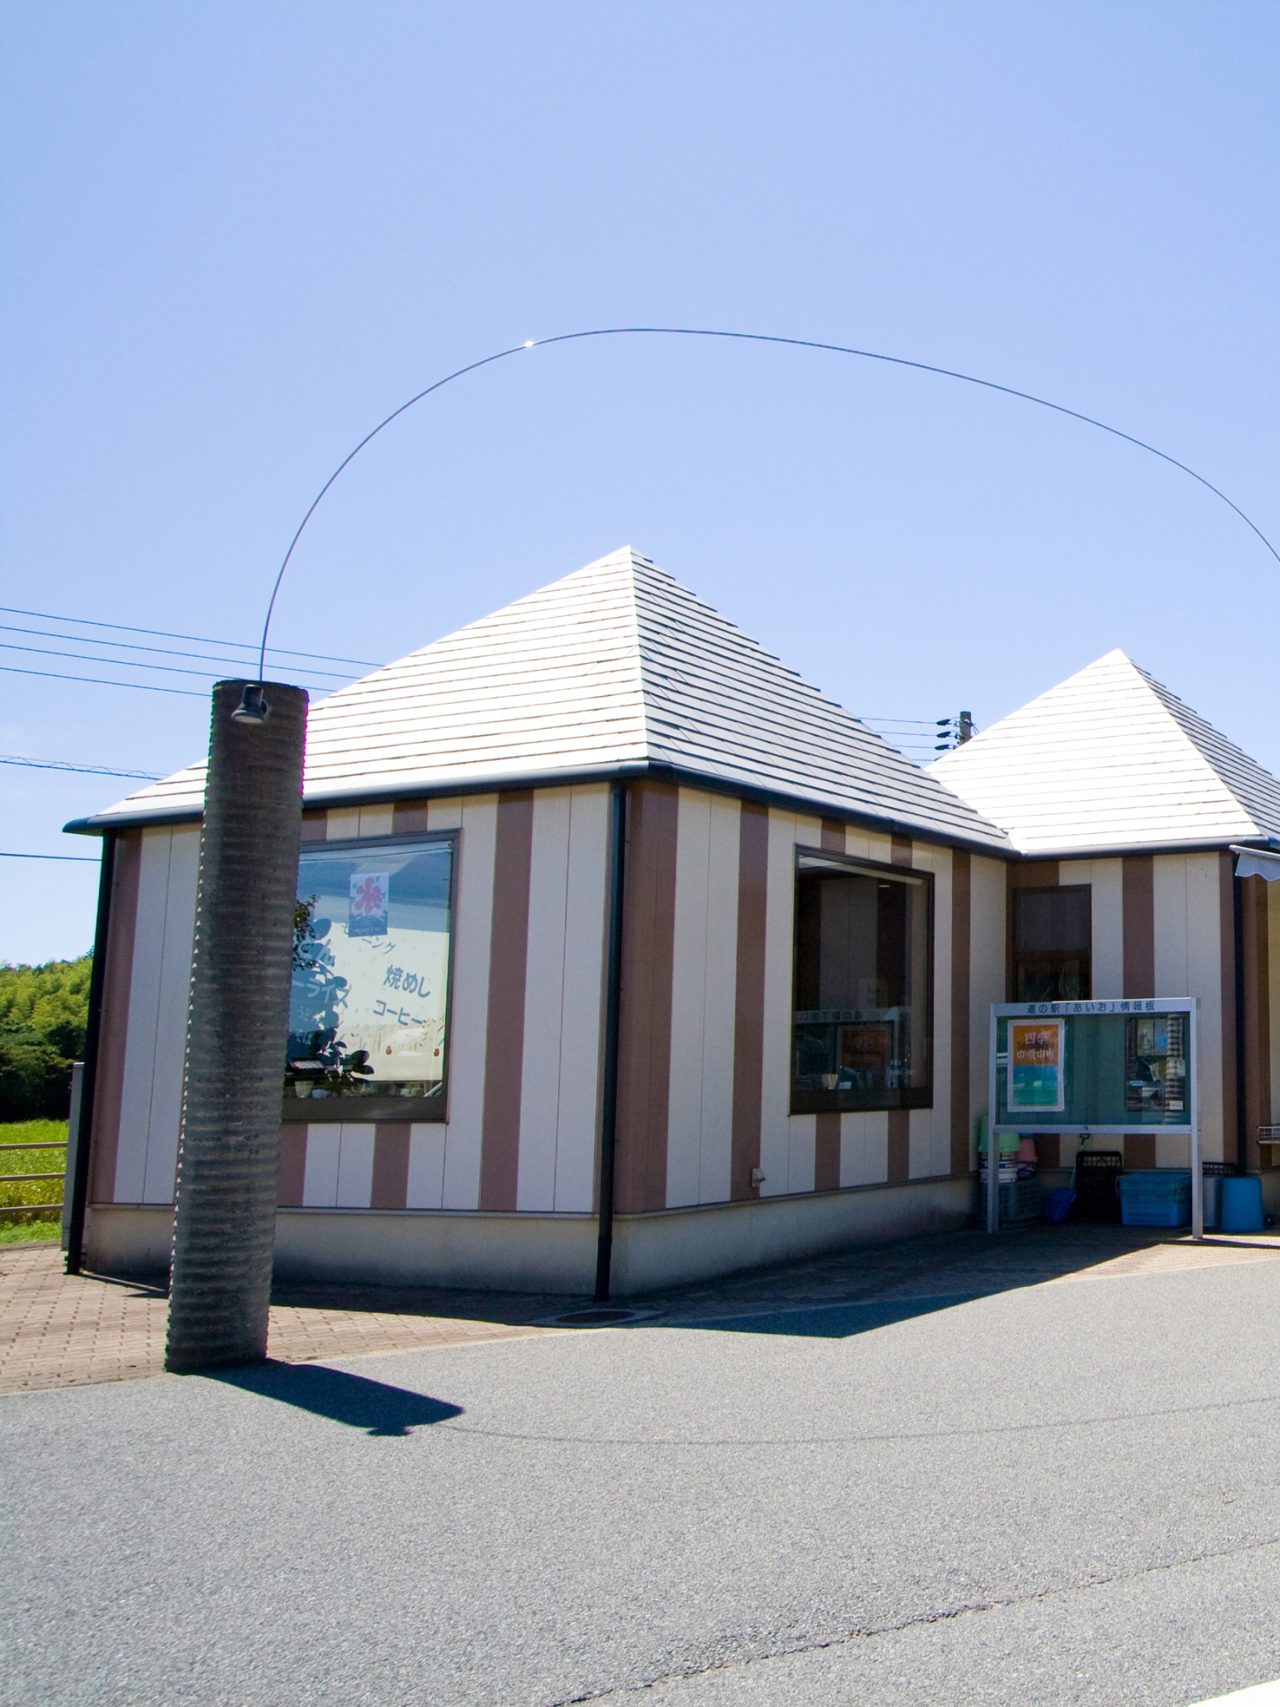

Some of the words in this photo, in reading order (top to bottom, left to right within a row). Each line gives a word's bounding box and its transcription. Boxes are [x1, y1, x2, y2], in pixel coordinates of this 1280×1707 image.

[383, 964, 431, 998] 焼めし
[373, 999, 423, 1026] コーヒー
[1026, 1001, 1156, 1014] 道の駅「あいお」情報板
